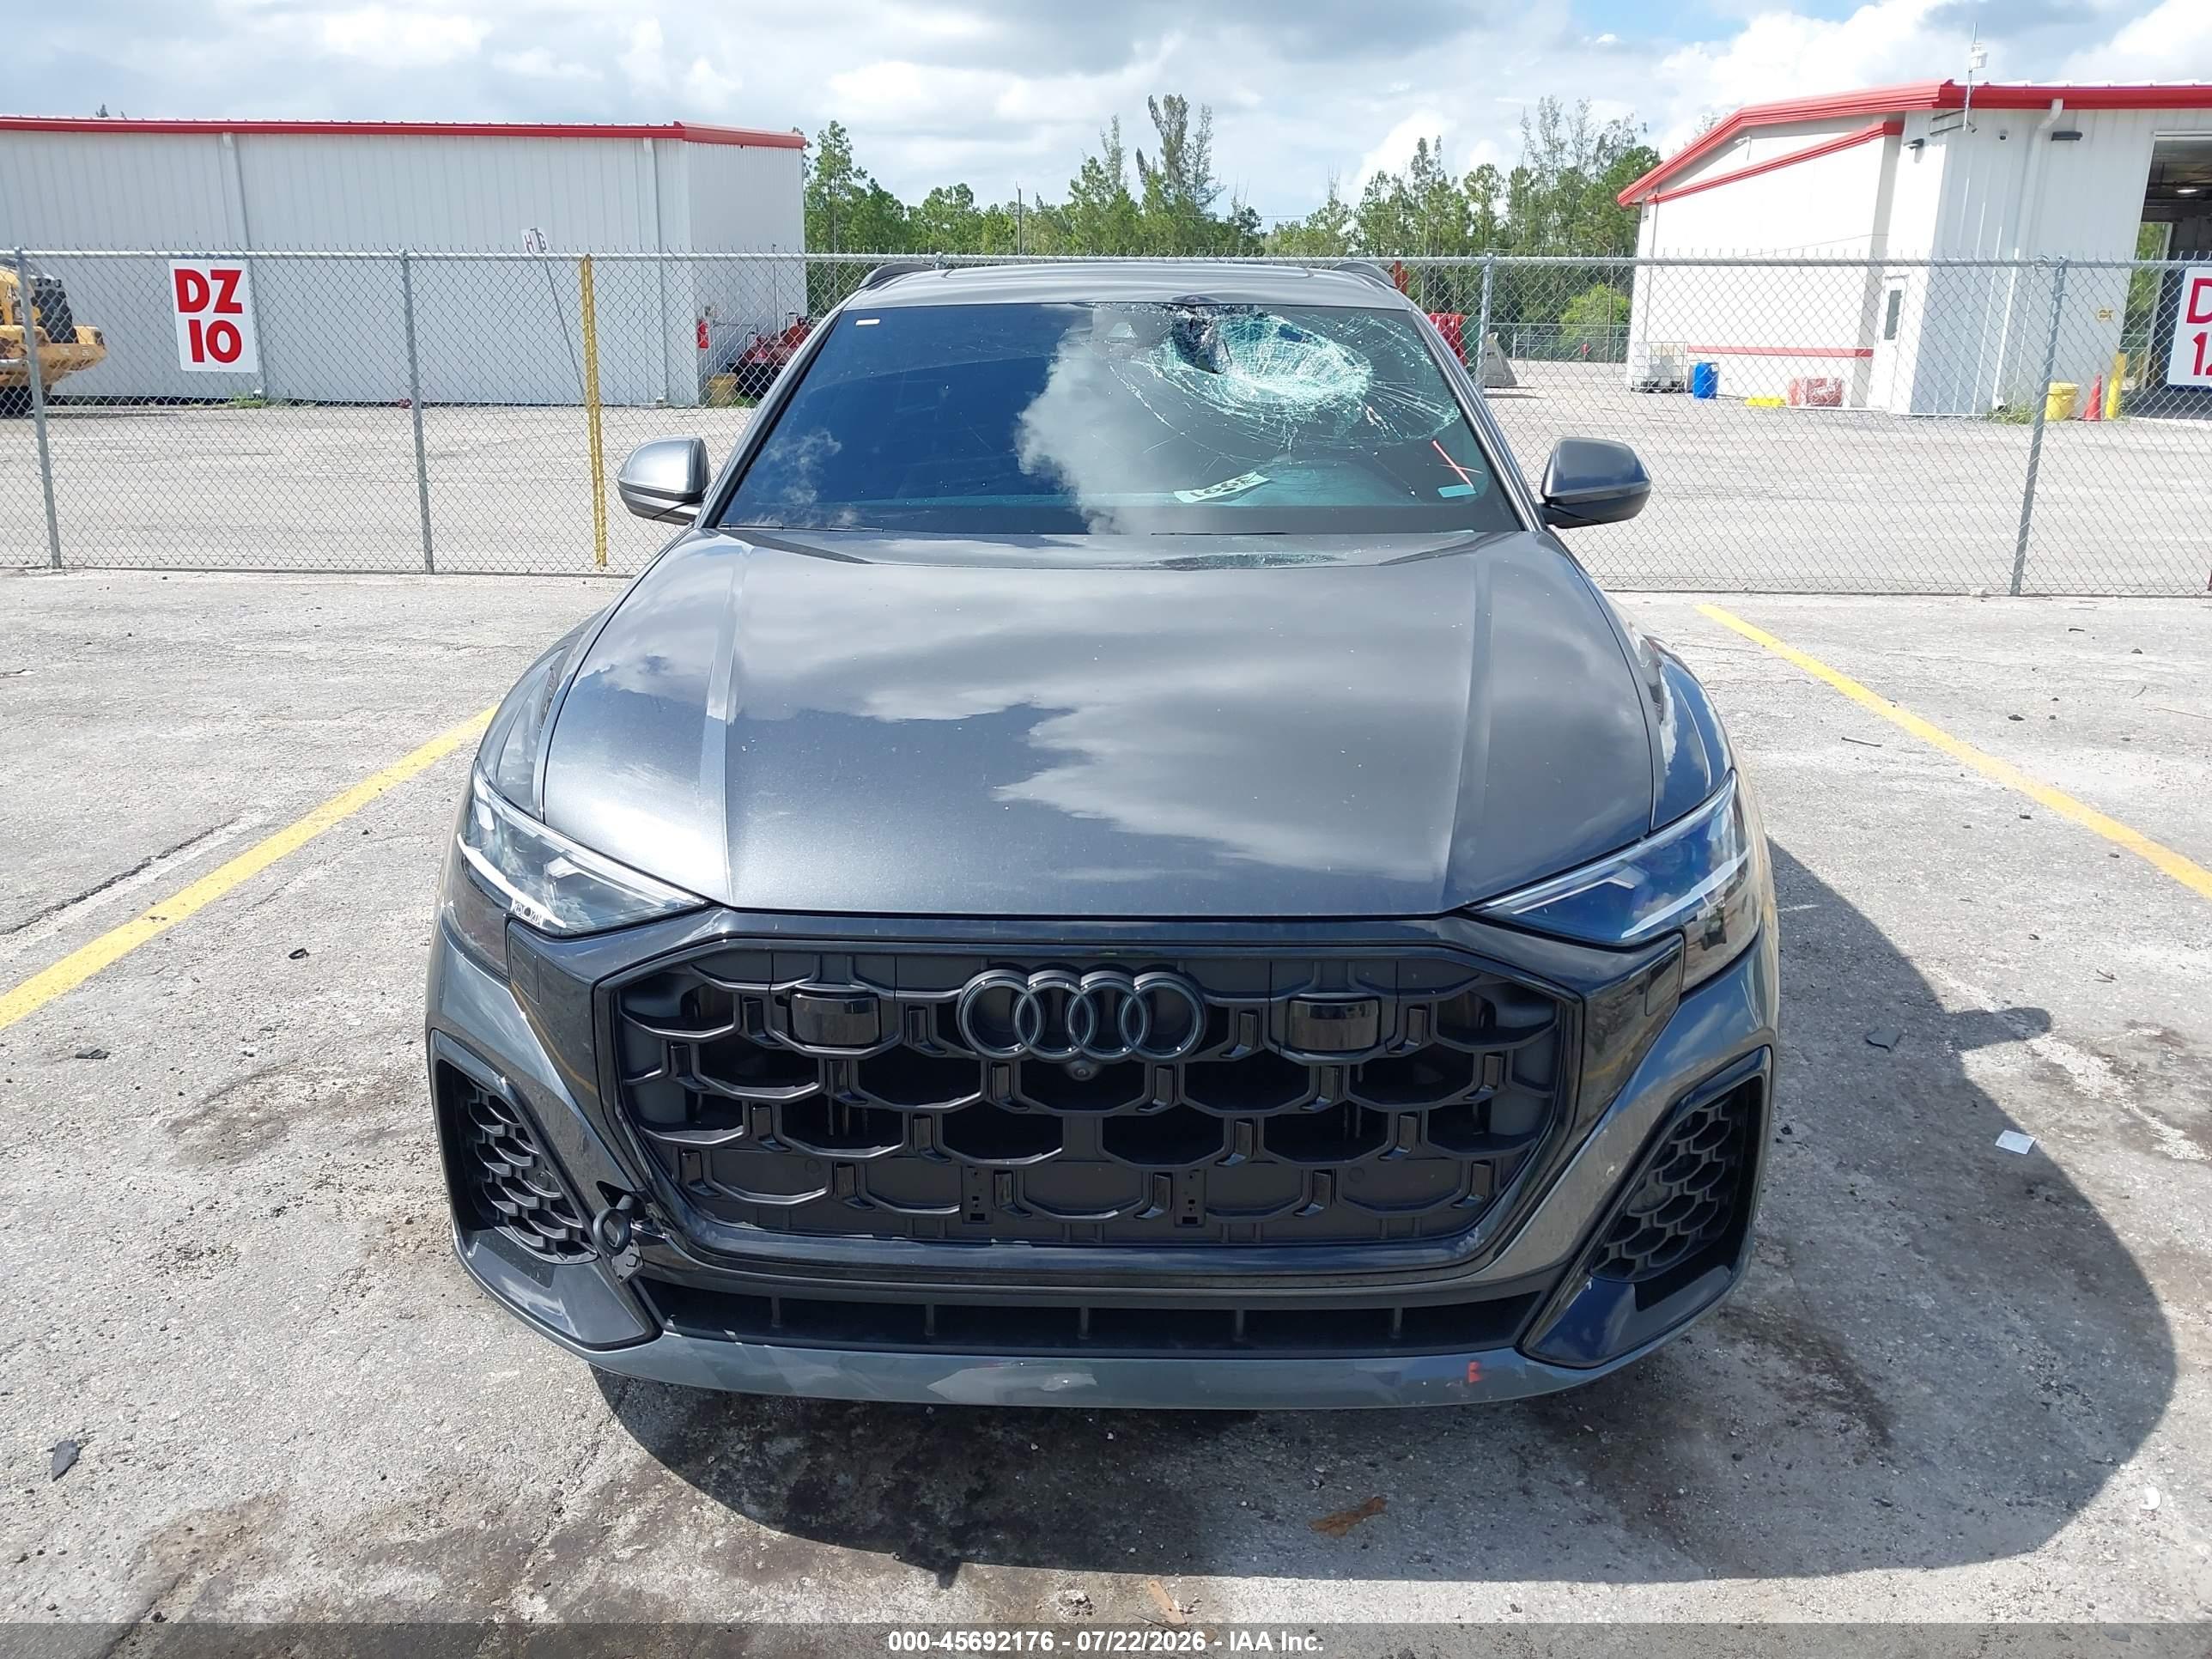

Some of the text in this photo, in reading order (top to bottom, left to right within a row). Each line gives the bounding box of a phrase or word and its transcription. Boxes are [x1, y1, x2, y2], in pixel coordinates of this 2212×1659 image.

[174, 269, 243, 313] DZ
[188, 319, 241, 363] 10
[2192, 332, 2212, 376] 1
